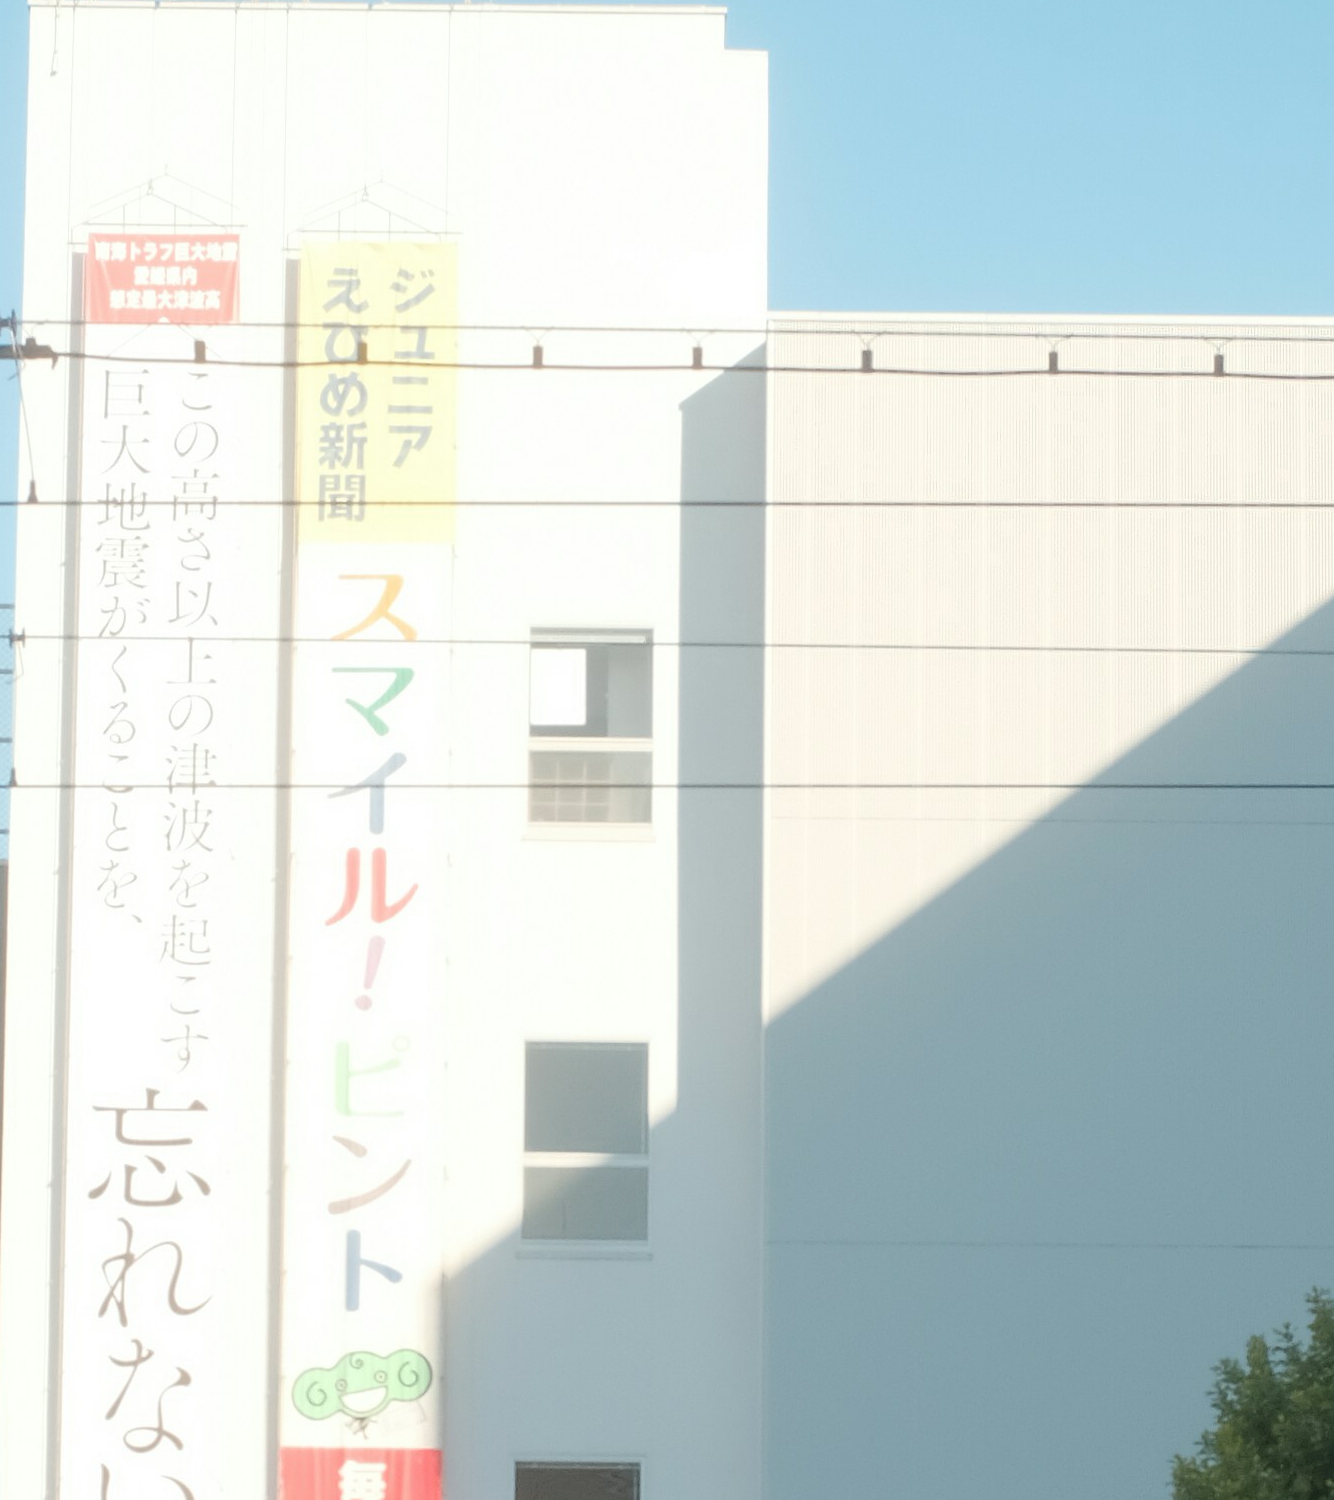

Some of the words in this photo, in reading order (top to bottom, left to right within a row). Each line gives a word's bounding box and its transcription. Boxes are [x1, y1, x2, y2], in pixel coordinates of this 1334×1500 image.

[317, 267, 370, 521] えひめ新聞
[387, 267, 436, 469] ジュニア
[159, 370, 220, 1074] この高さ以上の津波を起こす
